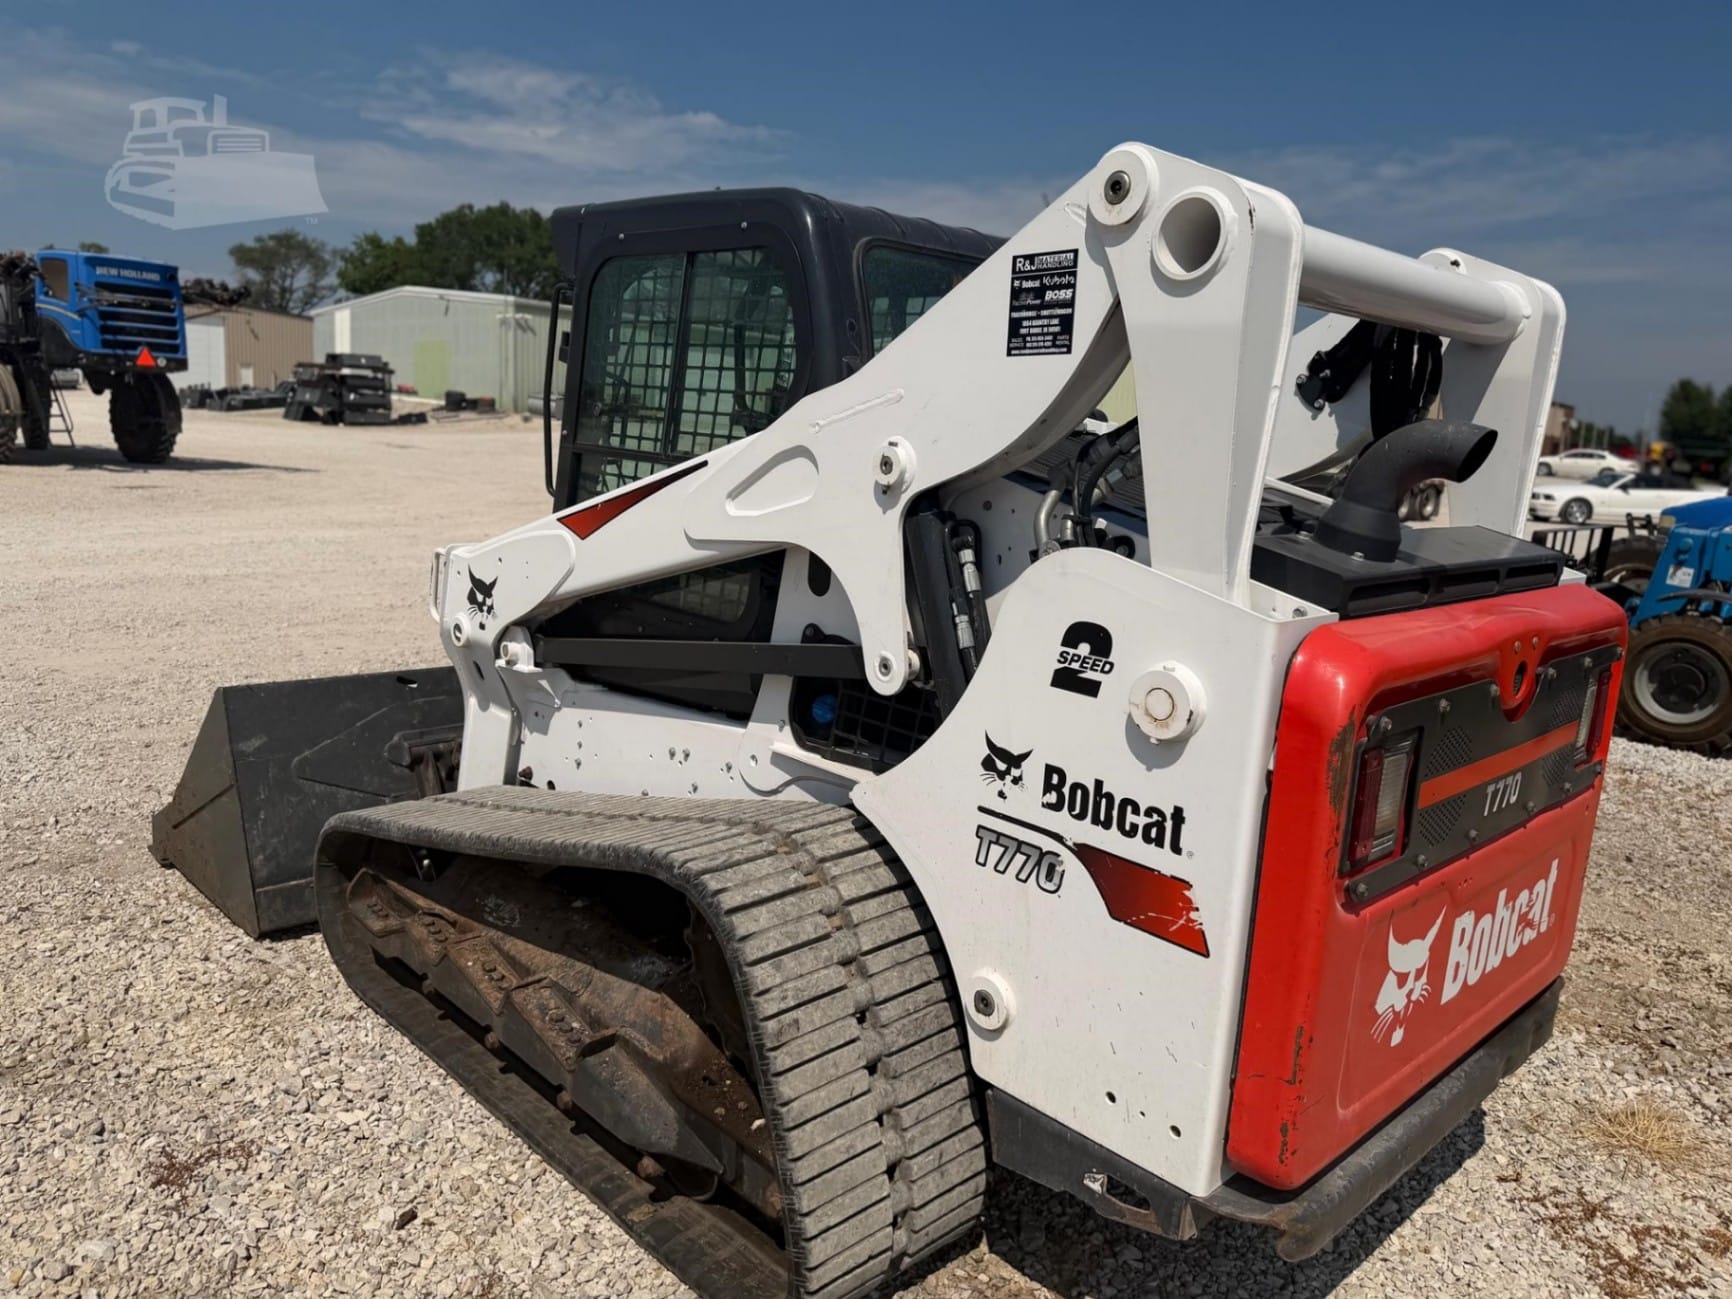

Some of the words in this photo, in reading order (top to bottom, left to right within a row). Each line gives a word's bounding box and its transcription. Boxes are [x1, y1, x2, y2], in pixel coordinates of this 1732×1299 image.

[96, 265, 118, 277] NEW
[119, 267, 160, 282] HOLLAND
[1015, 256, 1037, 272] R&J
[1021, 279, 1041, 289] Bobcat
[1042, 274, 1075, 286] Kubota
[1044, 288, 1074, 301] BOSS
[1050, 620, 1114, 698] 2
[1056, 650, 1115, 676] SPEED
[1482, 771, 1522, 817] T770
[1040, 762, 1186, 856] Bobcat
[974, 824, 1067, 895] T770
[1440, 858, 1559, 1006] Bobcat
